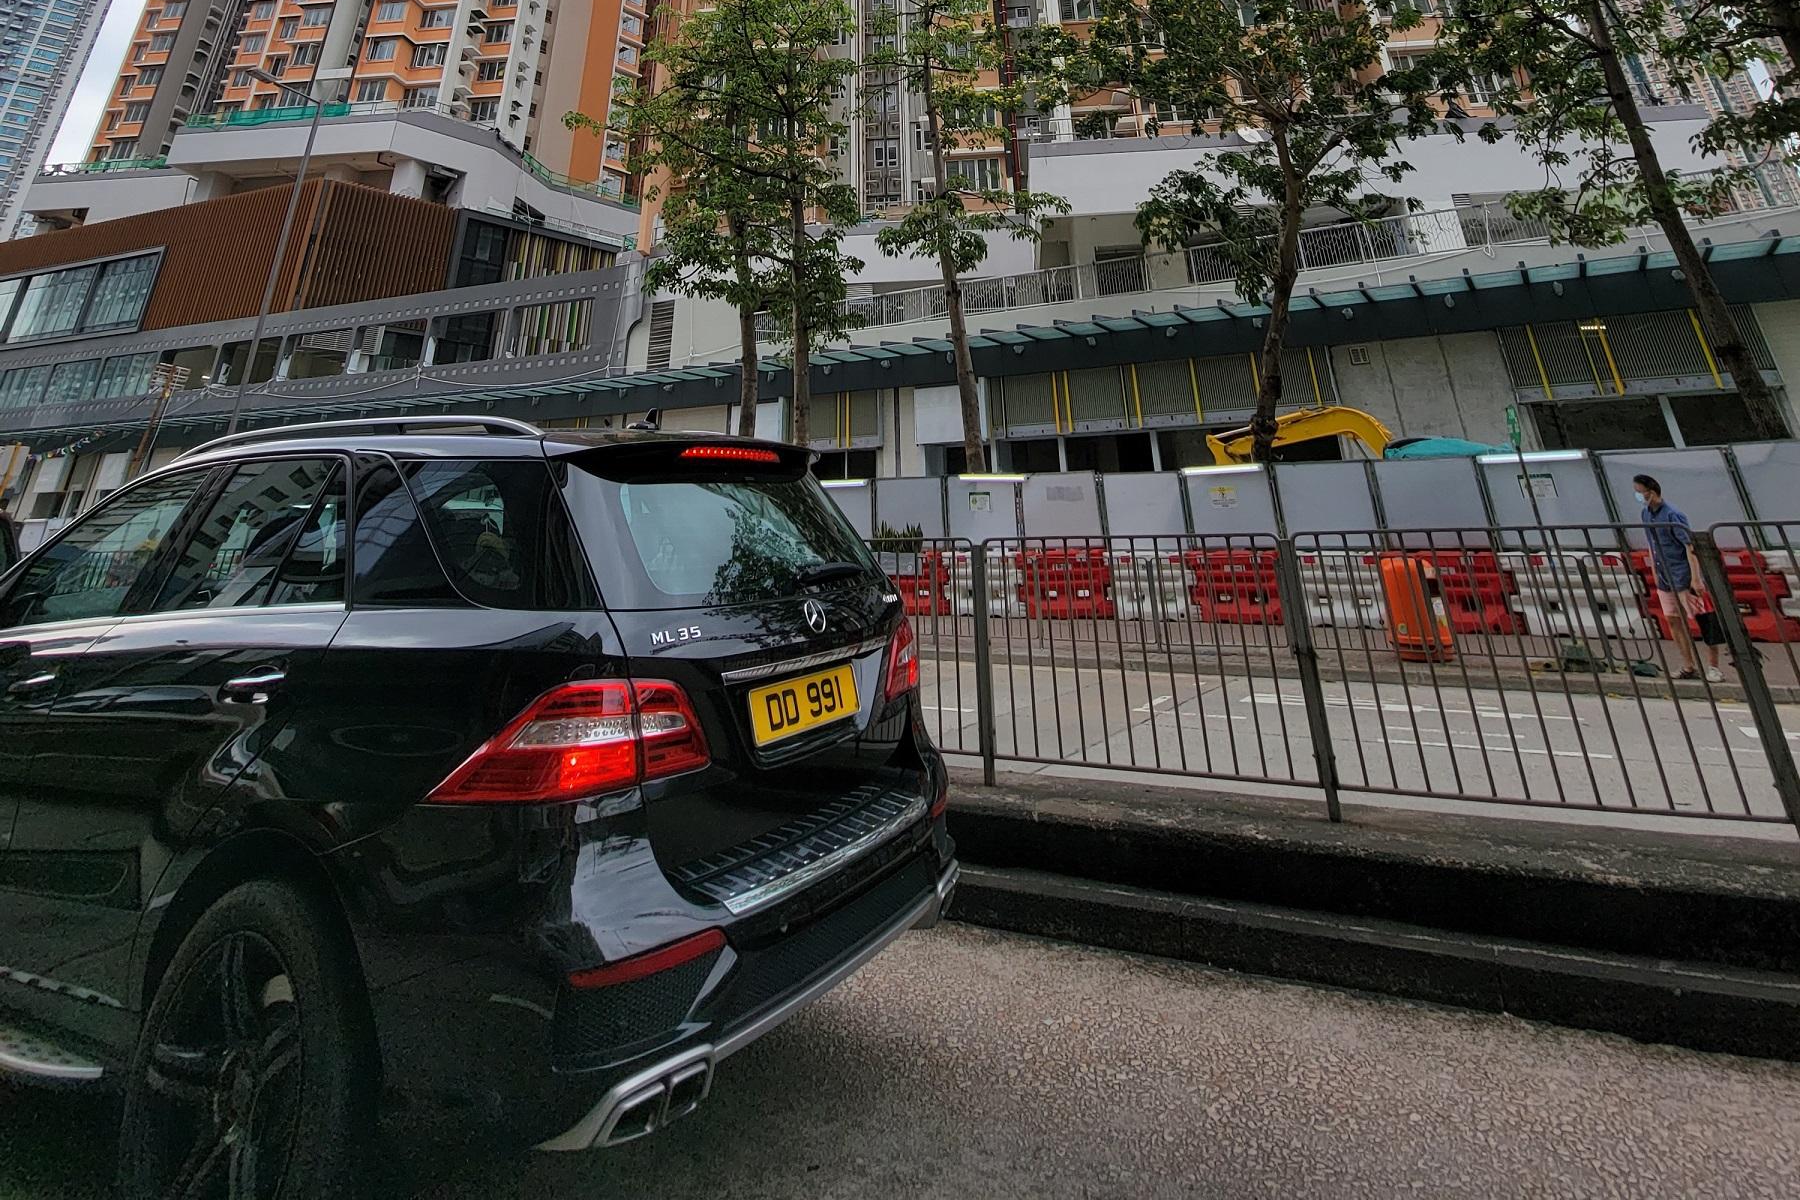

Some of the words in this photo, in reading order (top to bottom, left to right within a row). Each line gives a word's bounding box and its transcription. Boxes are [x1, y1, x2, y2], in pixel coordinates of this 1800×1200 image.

[650, 630, 676, 645] ML
[677, 625, 702, 641] 35
[765, 688, 800, 732] DD
[806, 675, 844, 718] 991
